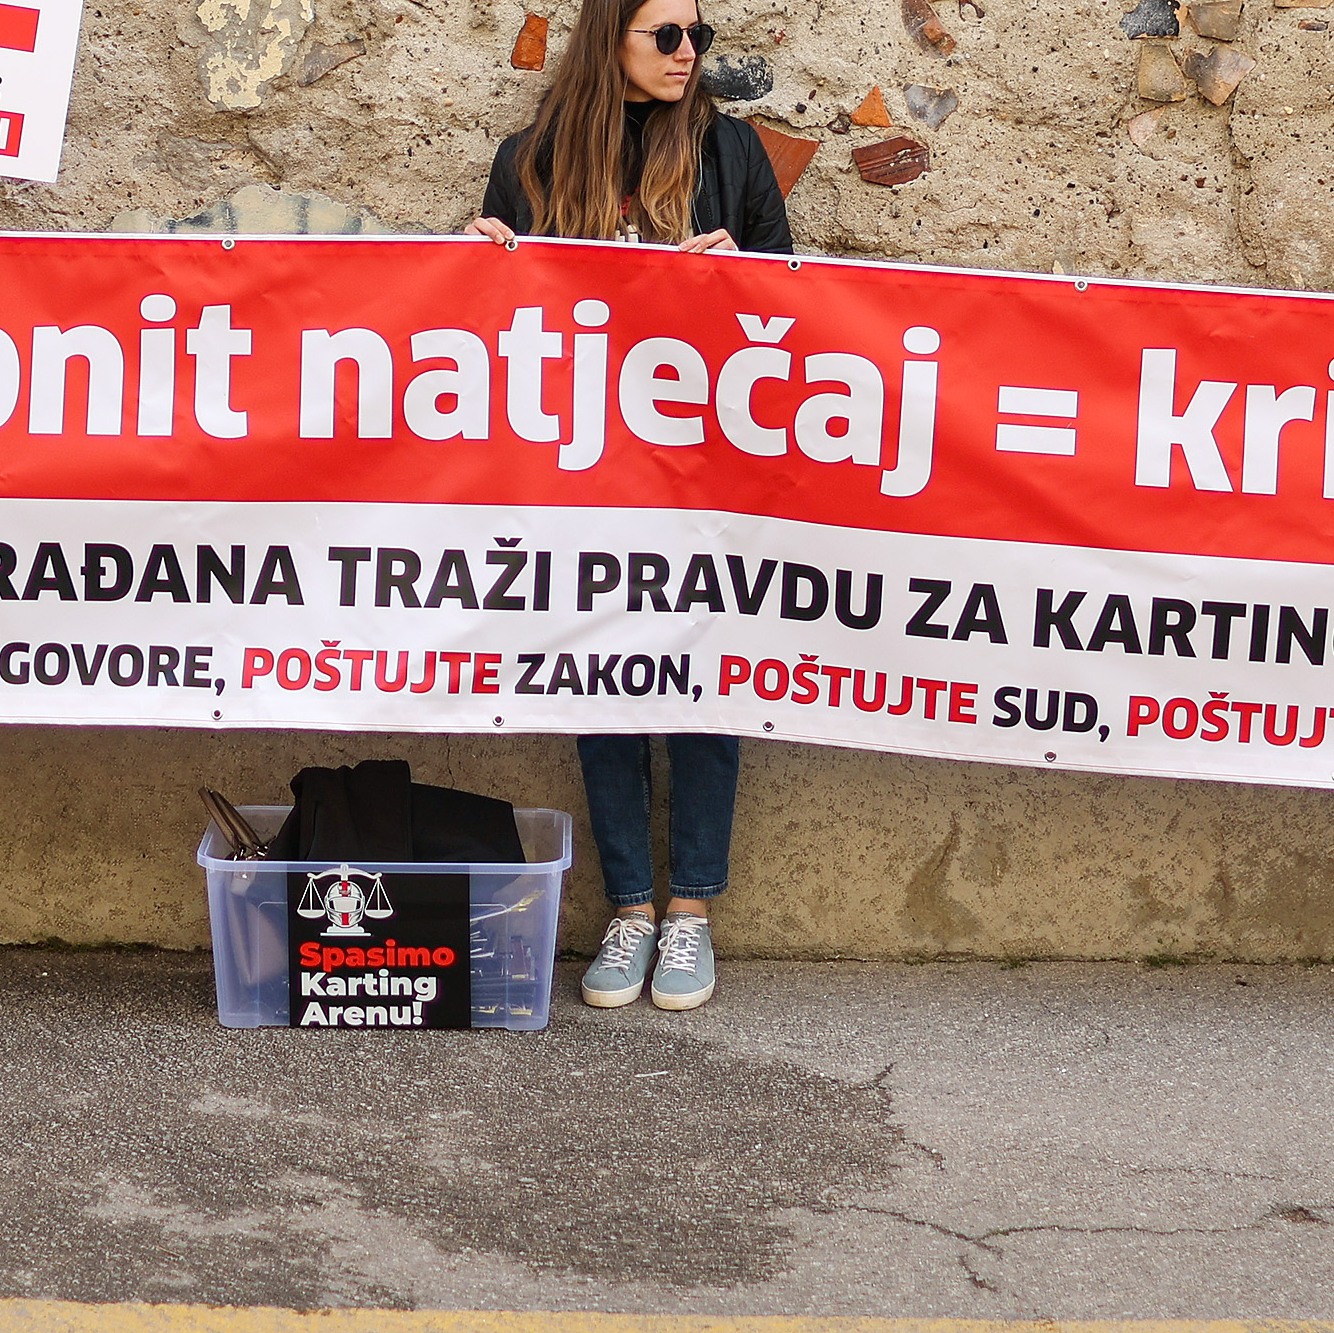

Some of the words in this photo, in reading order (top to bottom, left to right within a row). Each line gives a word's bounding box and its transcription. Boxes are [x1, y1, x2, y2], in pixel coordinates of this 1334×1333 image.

[300, 298, 942, 498] natječaj
[996, 385, 1078, 456] =
[328, 537, 551, 612] TRAŽI
[577, 551, 884, 630] PRAVDU
[906, 578, 1008, 646] ZA
[240, 640, 501, 696] POŠTUJTE
[515, 652, 703, 703] ZAKON,
[718, 654, 977, 726] POŠTUJTE
[992, 685, 1110, 742] SUD,
[299, 939, 455, 974] Spasimo
[301, 969, 438, 1001] Karting
[300, 1002, 422, 1027] Arenu!
